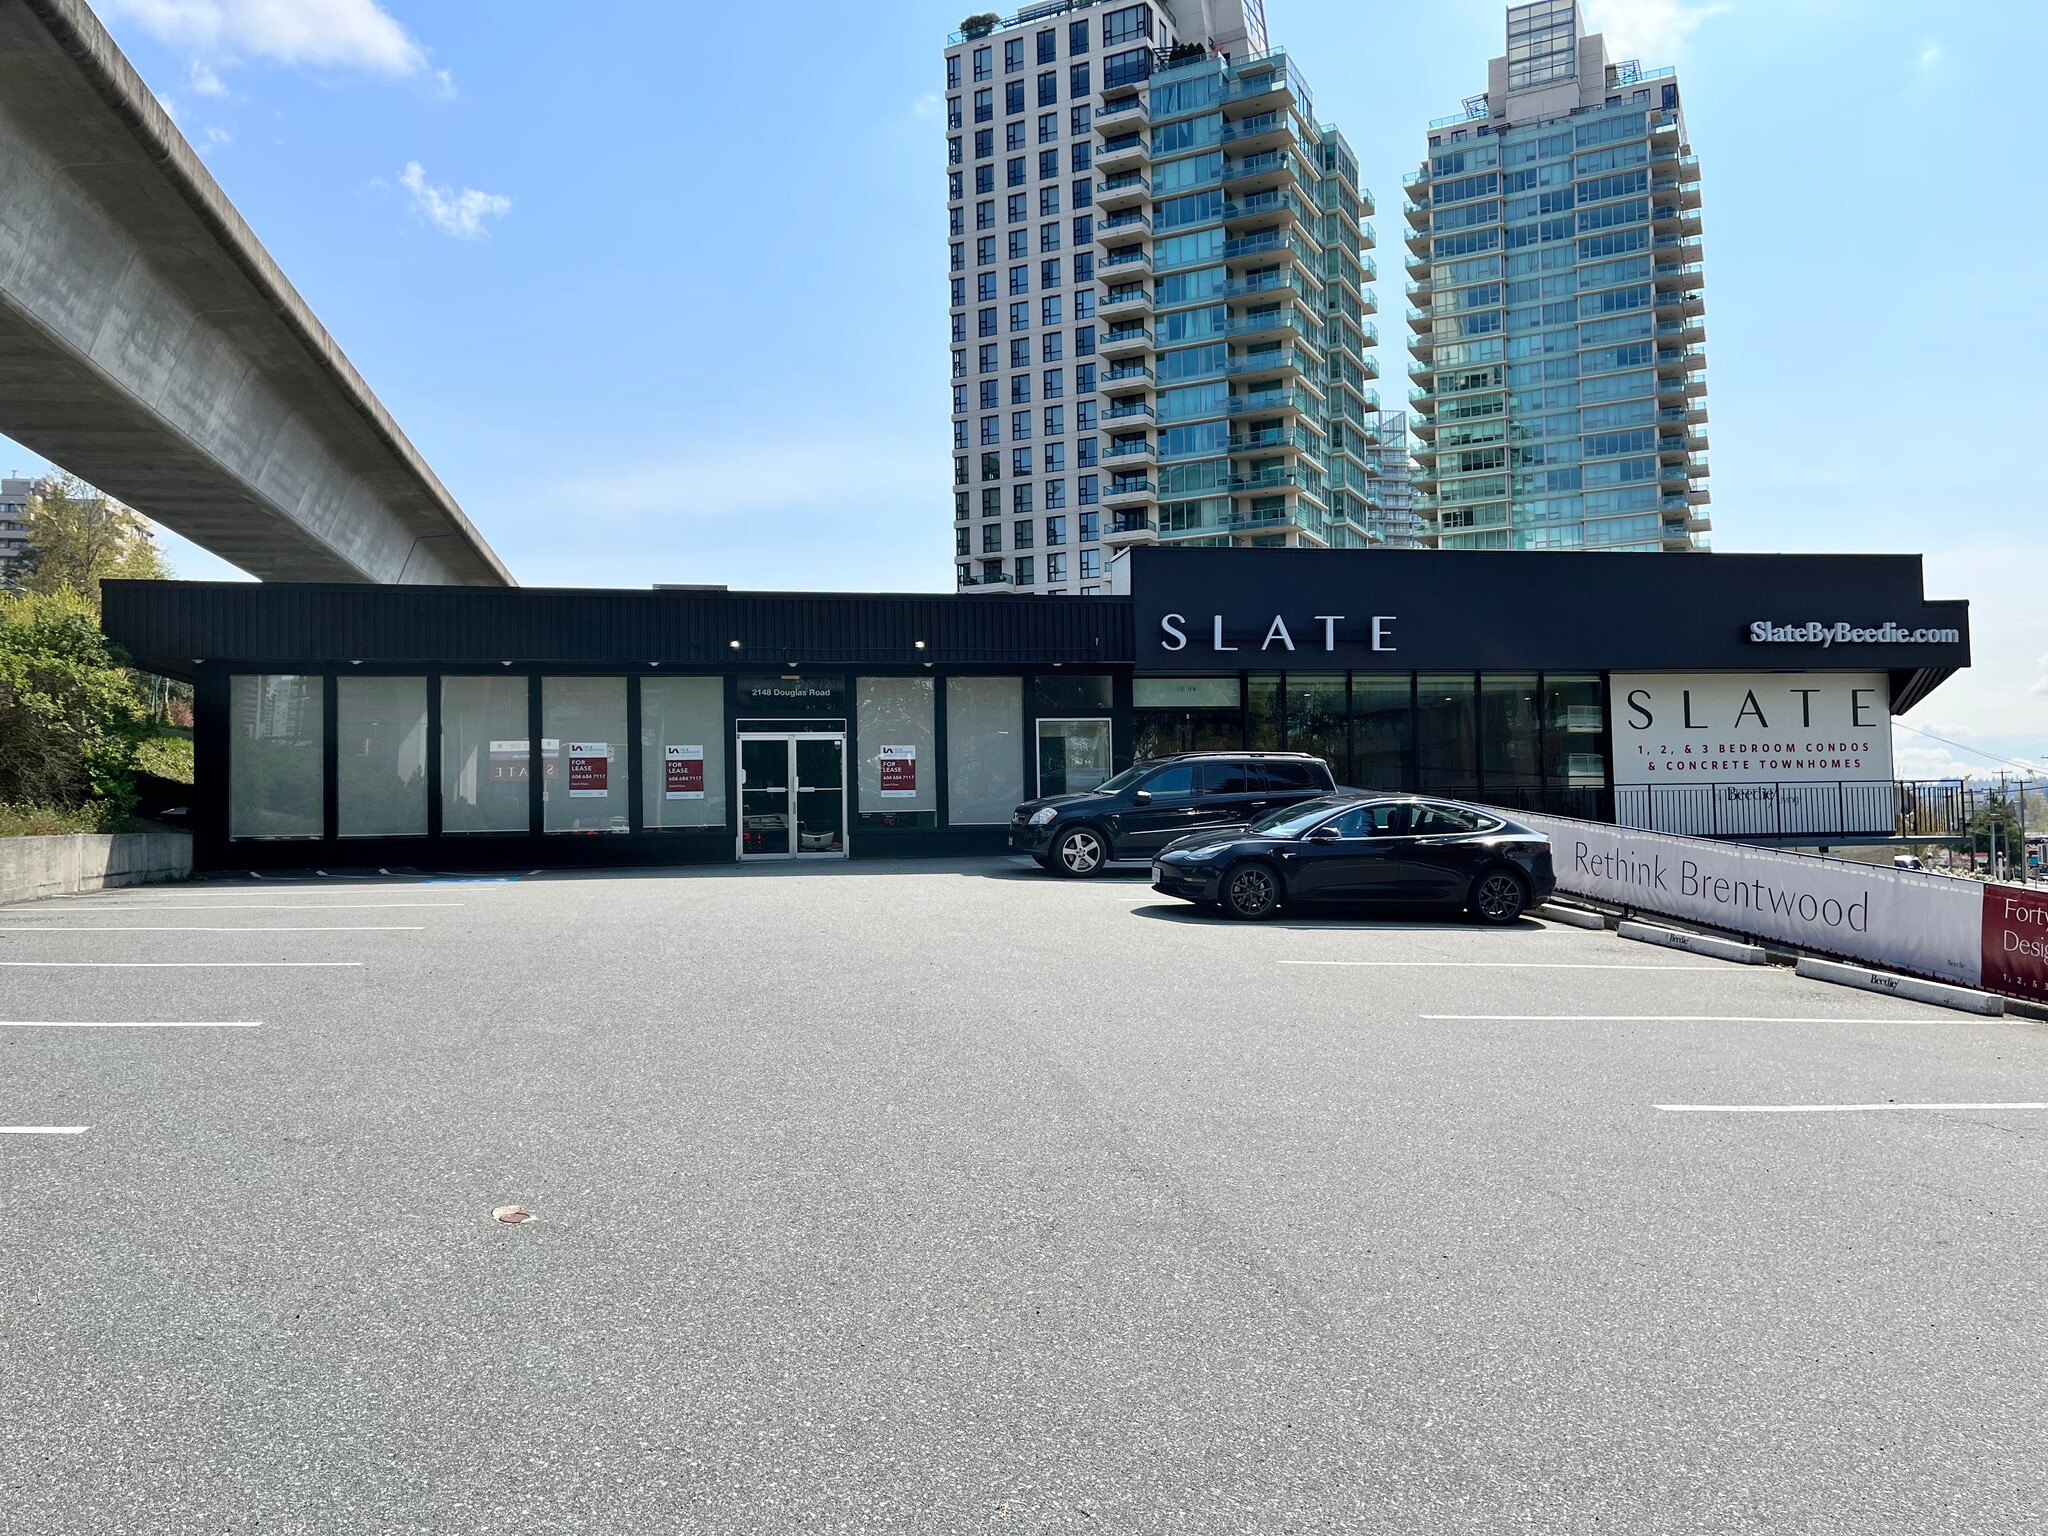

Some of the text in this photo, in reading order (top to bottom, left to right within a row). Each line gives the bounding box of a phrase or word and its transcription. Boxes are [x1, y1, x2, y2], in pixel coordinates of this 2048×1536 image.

[1161, 613, 1397, 651] SLATE
[1750, 621, 1959, 648] SlateByBeedie.com
[752, 688, 831, 698] 2148 Douglas Road
[1627, 689, 1877, 730] SLATE
[1638, 742, 1869, 755] 1, 2, & 3 BEDROOM CONDOS
[1648, 759, 1861, 771] & CONCRETE TOWNHOMES
[1575, 841, 1869, 933] Rethink Brentwood
[2003, 973, 2011, 983] 1,
[2017, 976, 2026, 987] 2,
